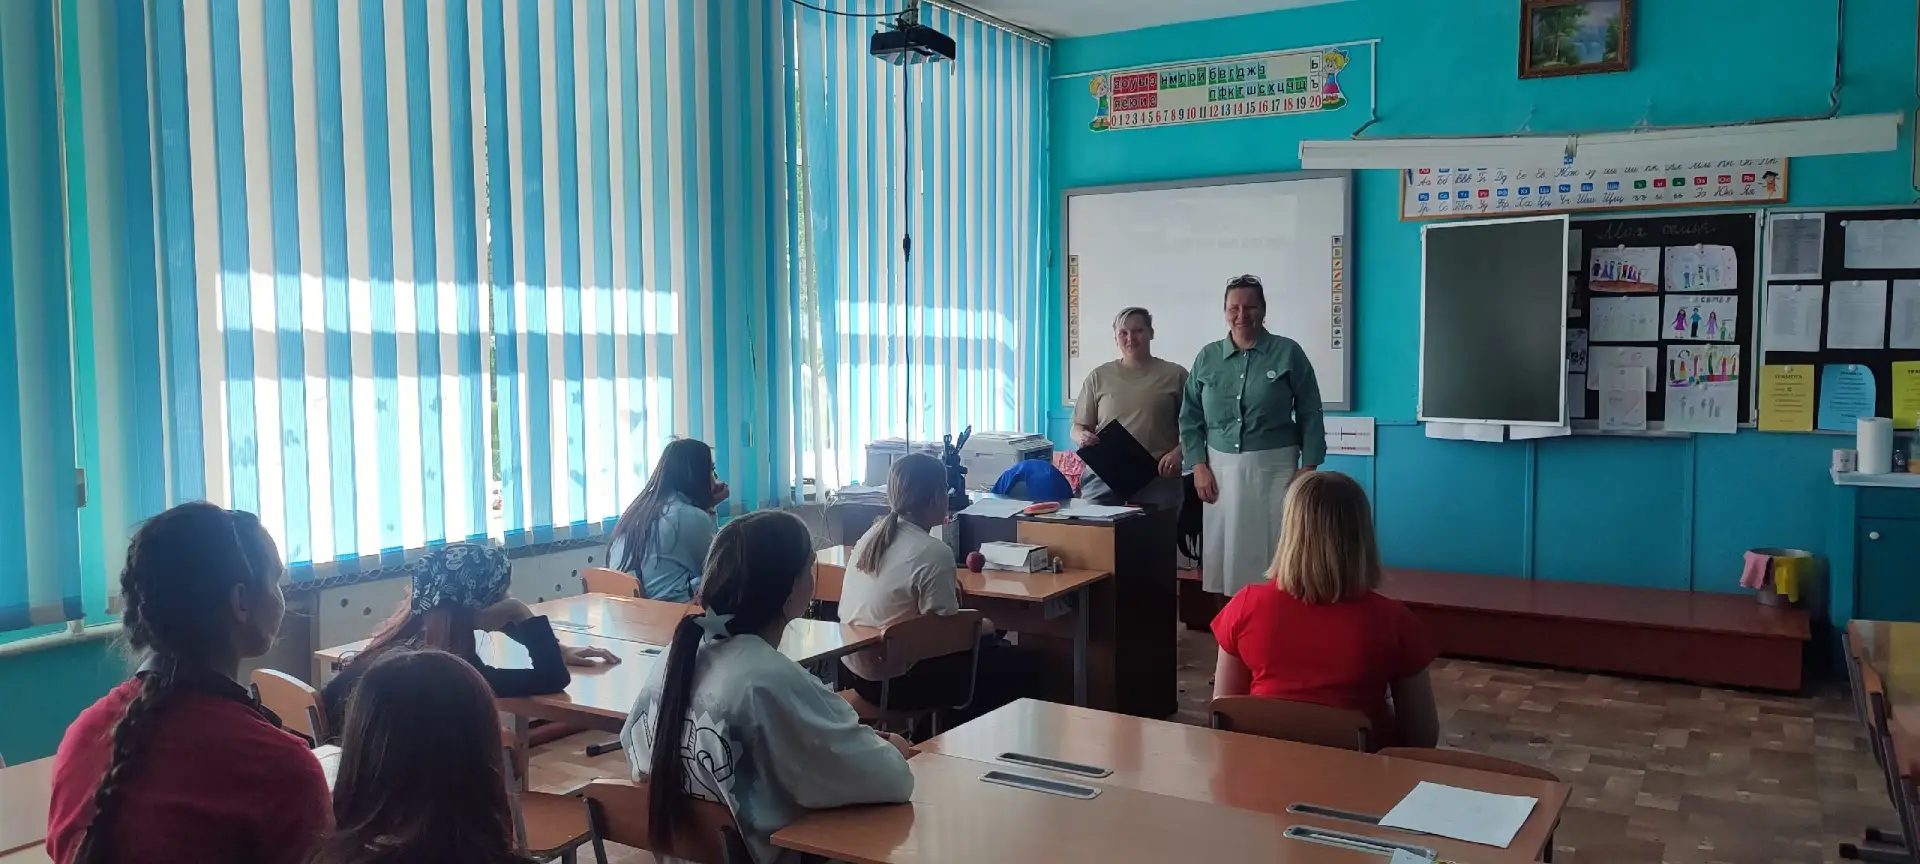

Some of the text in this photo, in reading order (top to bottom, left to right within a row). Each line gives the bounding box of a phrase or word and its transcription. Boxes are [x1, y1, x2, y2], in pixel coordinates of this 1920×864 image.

[1111, 95, 1321, 126] 0 1 2 3 4 5 6 7 8 9 10 11 12 13 14 15 16 17 18 19 20
